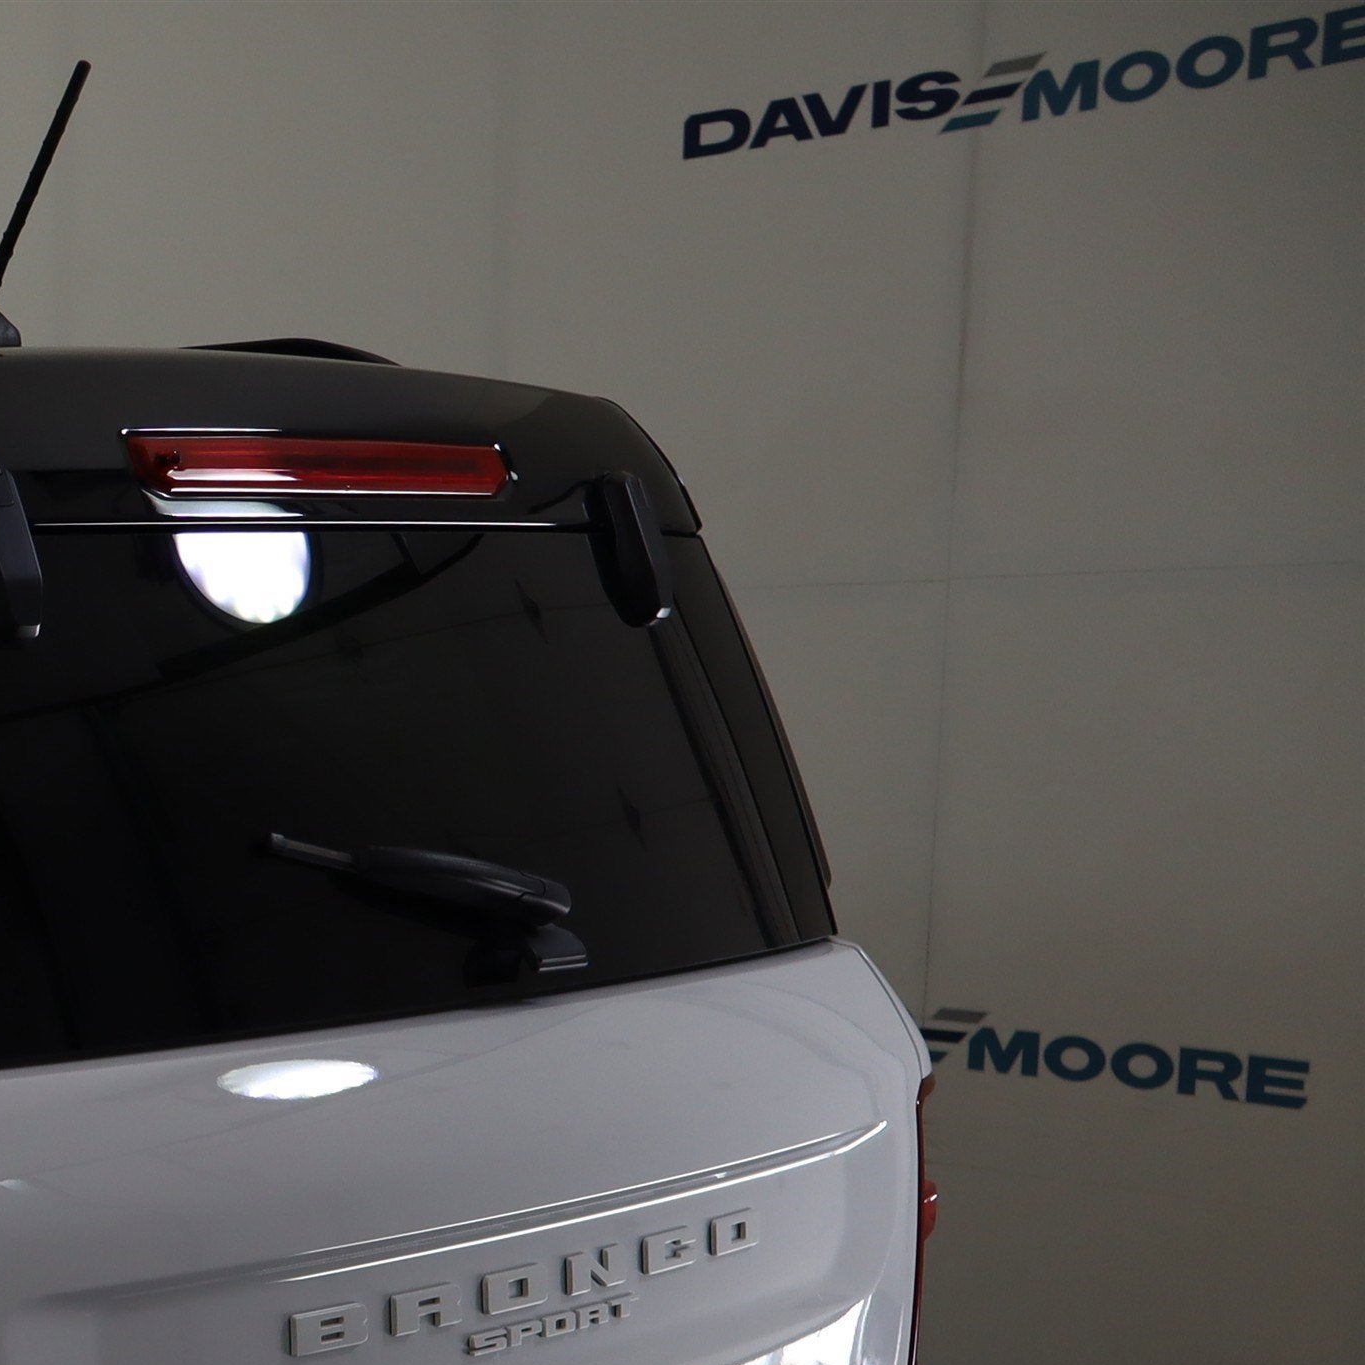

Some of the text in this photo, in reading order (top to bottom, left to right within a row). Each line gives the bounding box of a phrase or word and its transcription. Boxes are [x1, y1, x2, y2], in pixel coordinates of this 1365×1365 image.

[682, 4, 1365, 161] DAVIS MOORE
[967, 1026, 1311, 1110] MOORE
[288, 1207, 760, 1357] BRONCO
[466, 1291, 639, 1357] SPORT
